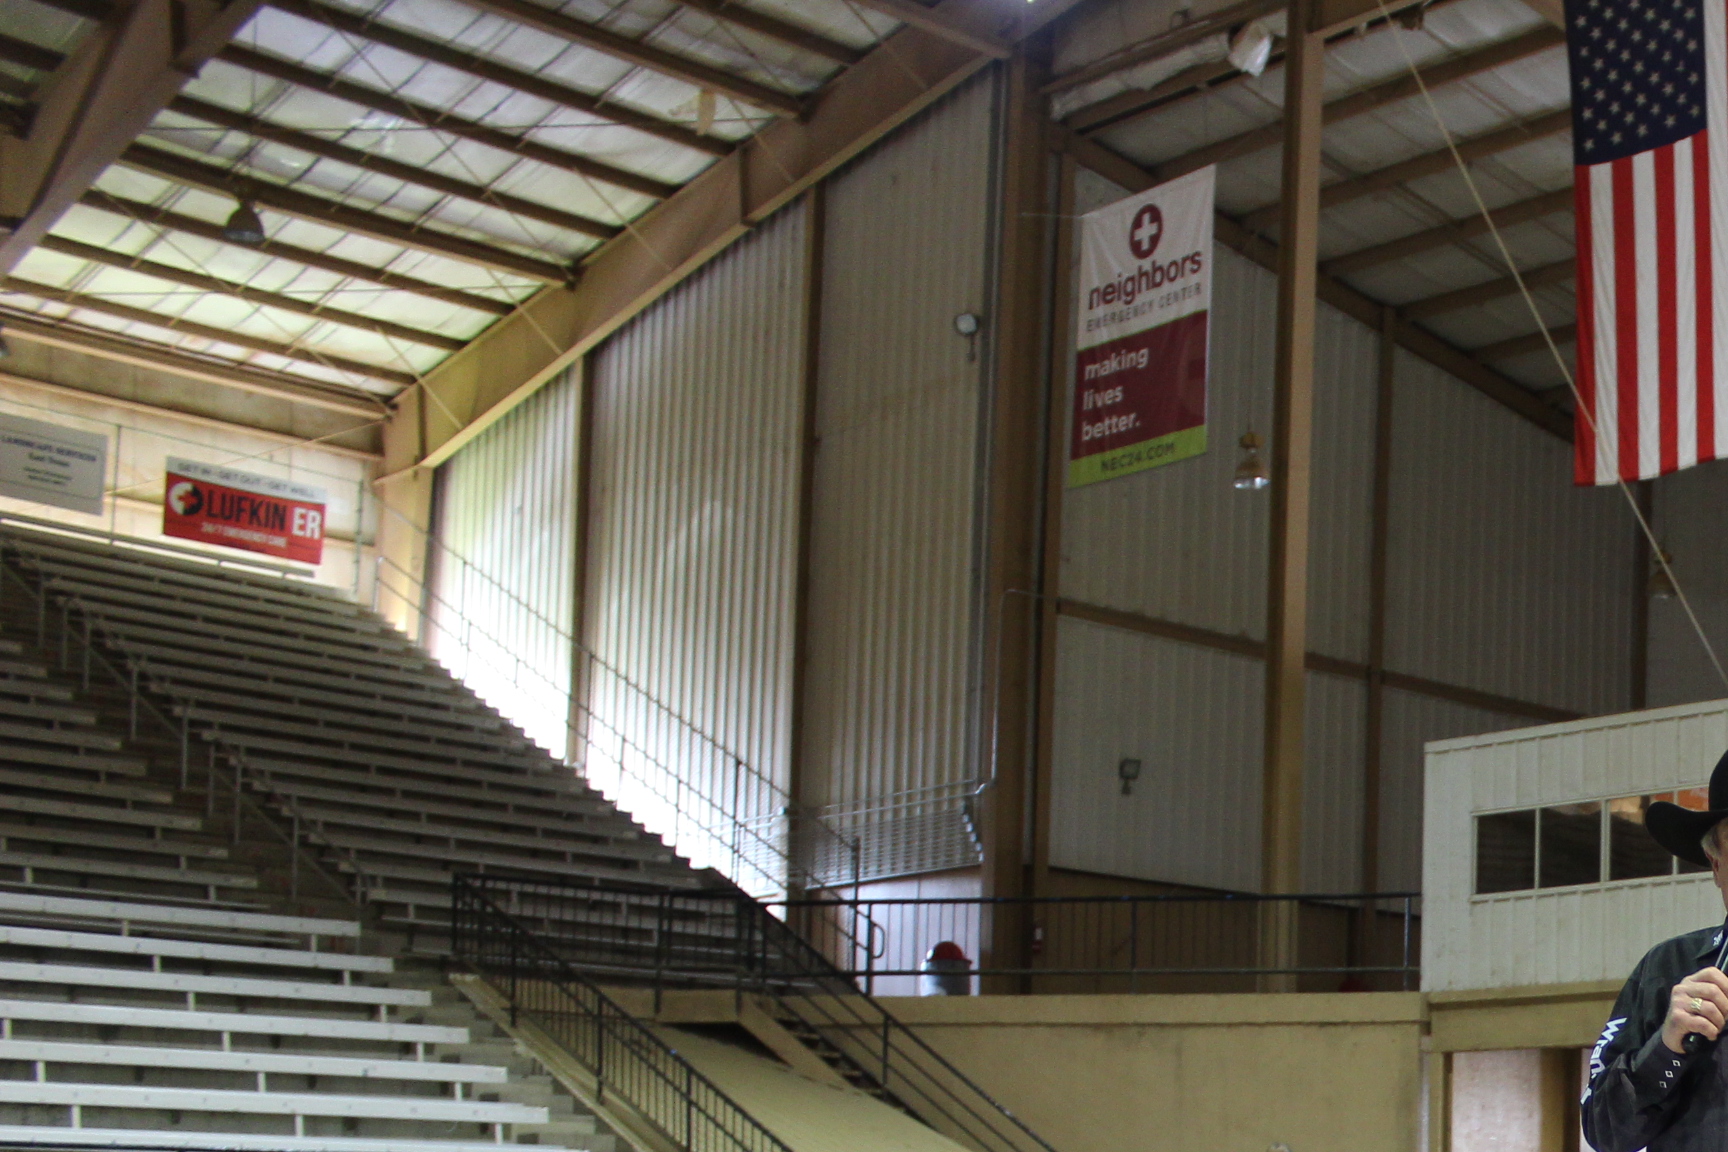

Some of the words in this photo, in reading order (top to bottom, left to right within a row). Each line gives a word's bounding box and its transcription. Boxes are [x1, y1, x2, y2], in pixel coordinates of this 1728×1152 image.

[1088, 250, 1202, 310] neighbors
[1087, 300, 1154, 332] EMERGENCY
[1158, 282, 1202, 309] CENTER
[1085, 347, 1149, 380] making
[1083, 386, 1123, 411] lives
[1082, 412, 1140, 441] better.
[206, 490, 288, 531] LUFKIN
[292, 506, 322, 540] ER
